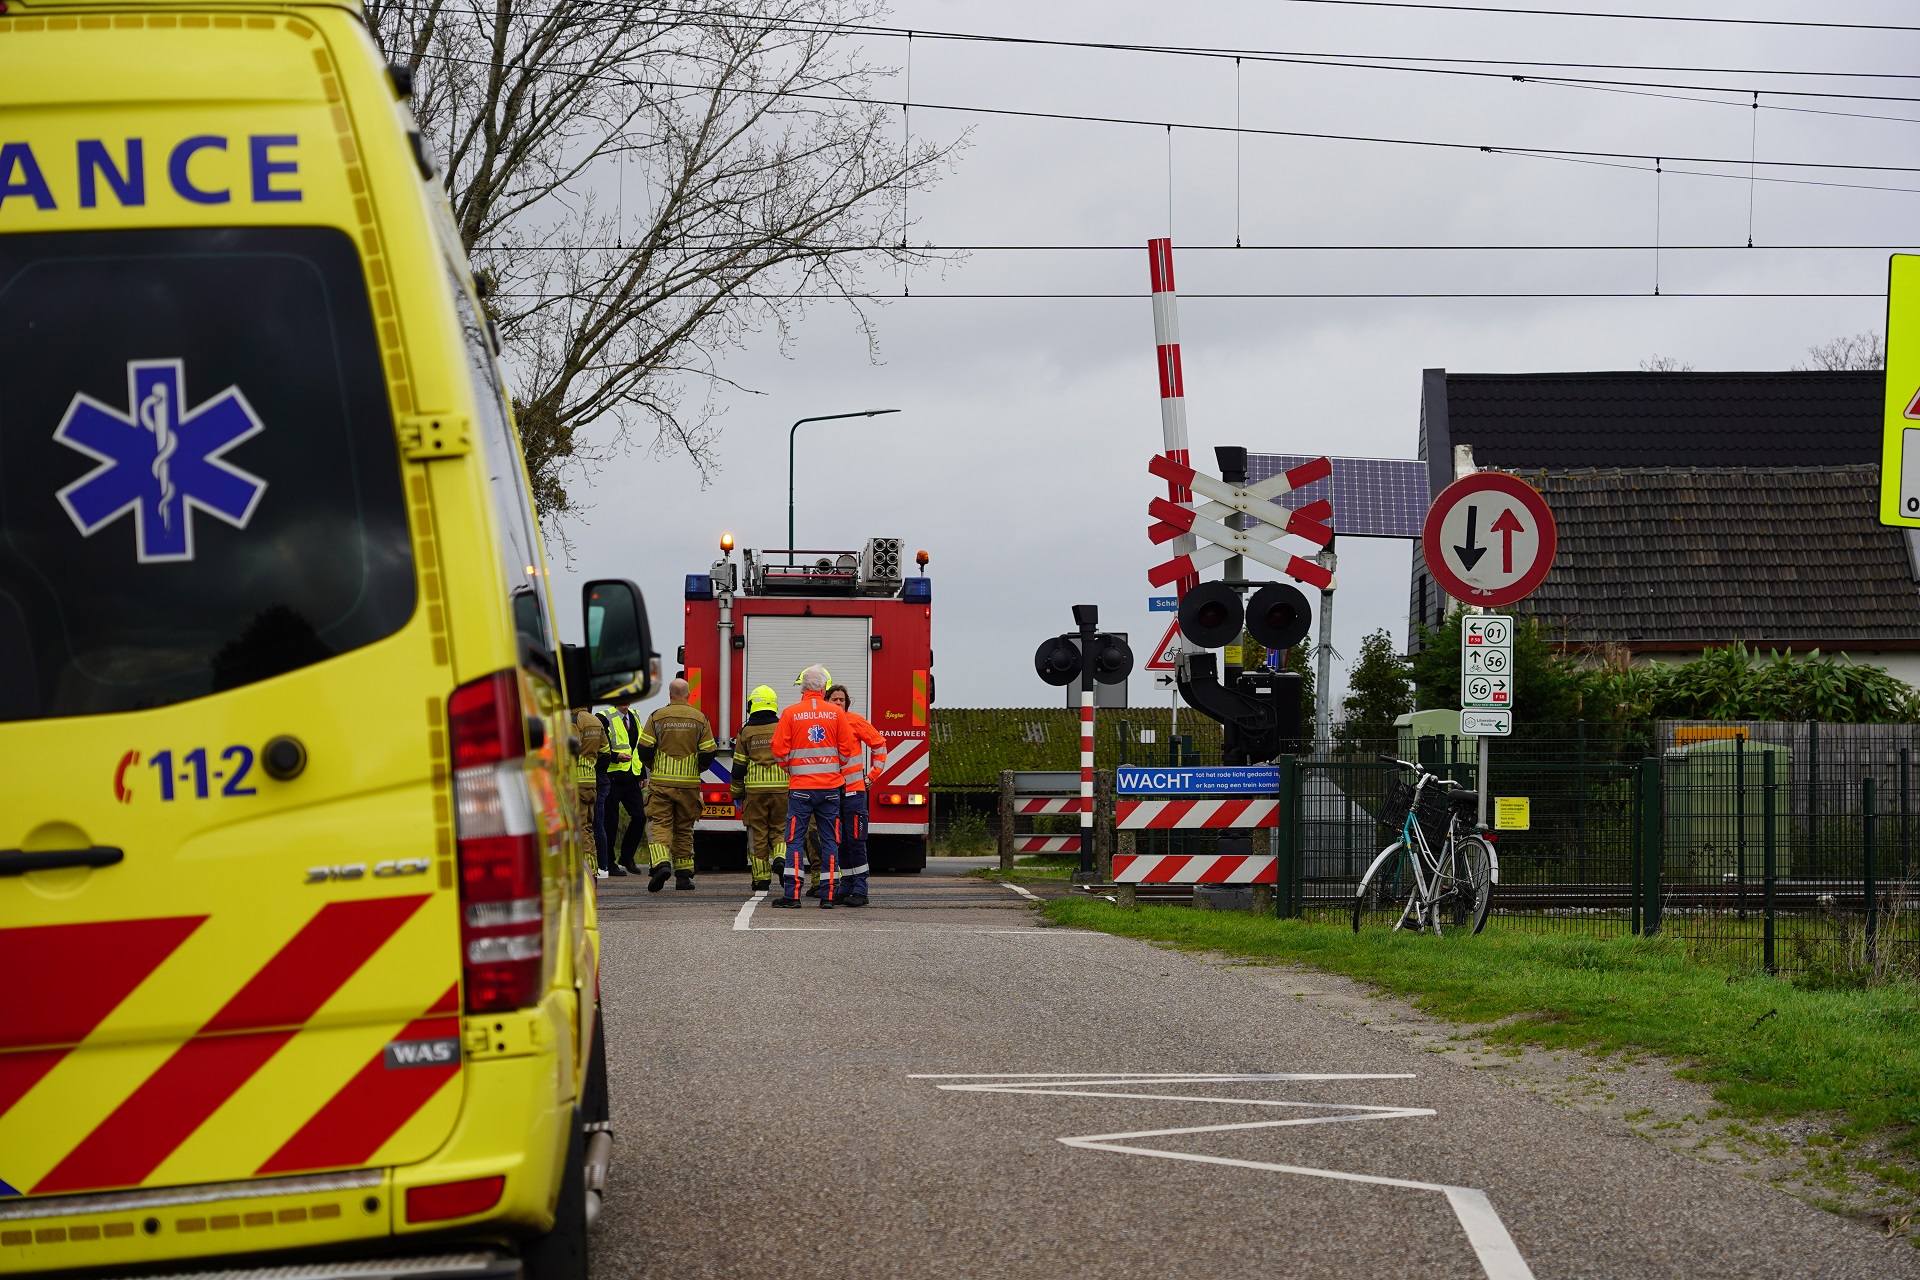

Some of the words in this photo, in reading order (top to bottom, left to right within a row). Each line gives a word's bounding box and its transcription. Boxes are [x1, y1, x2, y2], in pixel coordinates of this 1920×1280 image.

[0, 133, 303, 211] ANCE
[1487, 628, 1501, 638] 01
[1487, 656, 1502, 667] 56
[1472, 684, 1486, 694] 56
[794, 712, 836, 721] AMBULANCE
[149, 745, 257, 801] 1-1-2
[1118, 773, 1193, 789] WACHT
[392, 1042, 452, 1064] WAS
